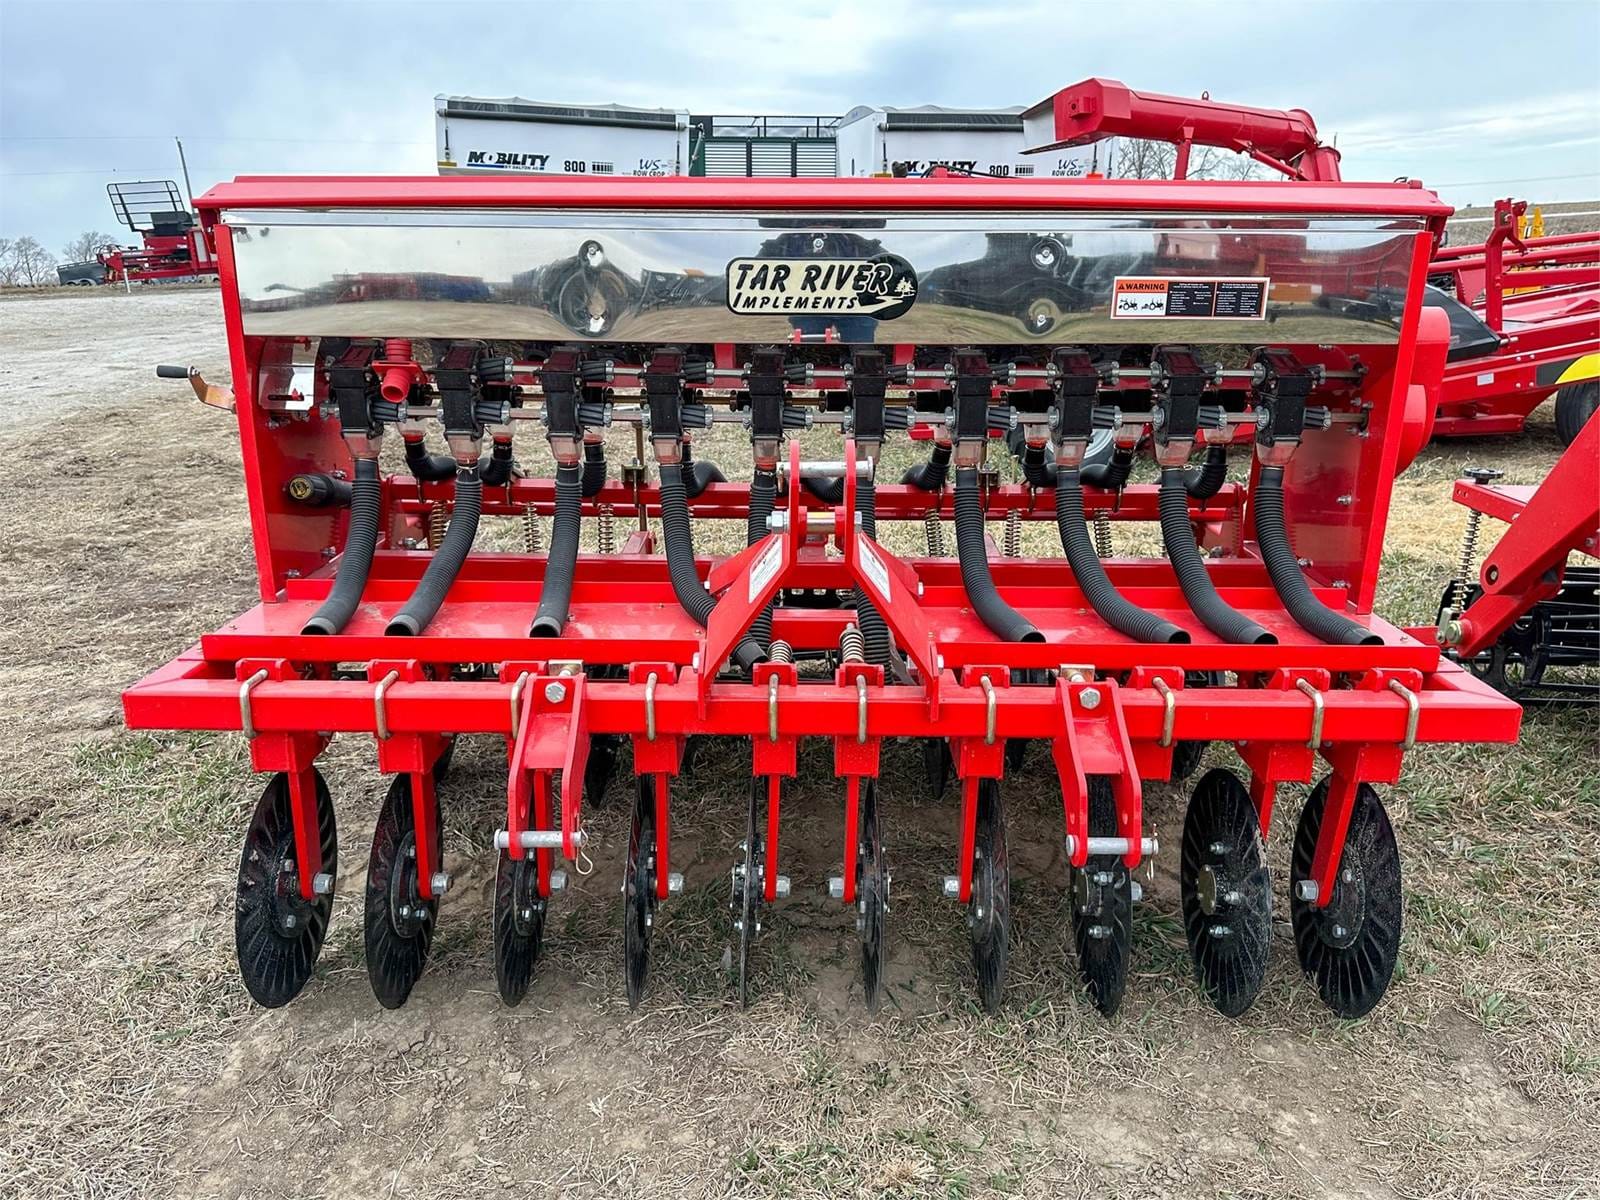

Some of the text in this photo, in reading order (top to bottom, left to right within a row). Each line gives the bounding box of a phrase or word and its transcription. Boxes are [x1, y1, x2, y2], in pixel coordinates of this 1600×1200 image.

[467, 151, 550, 166] MOBILITY
[640, 158, 661, 171] WS
[1058, 158, 1079, 170] WS
[564, 160, 586, 173] 800
[988, 164, 1009, 176] 800
[735, 263, 893, 295] TAR RIVER
[1125, 283, 1165, 291] WARNING
[732, 292, 858, 309] IMPLEMENTS
